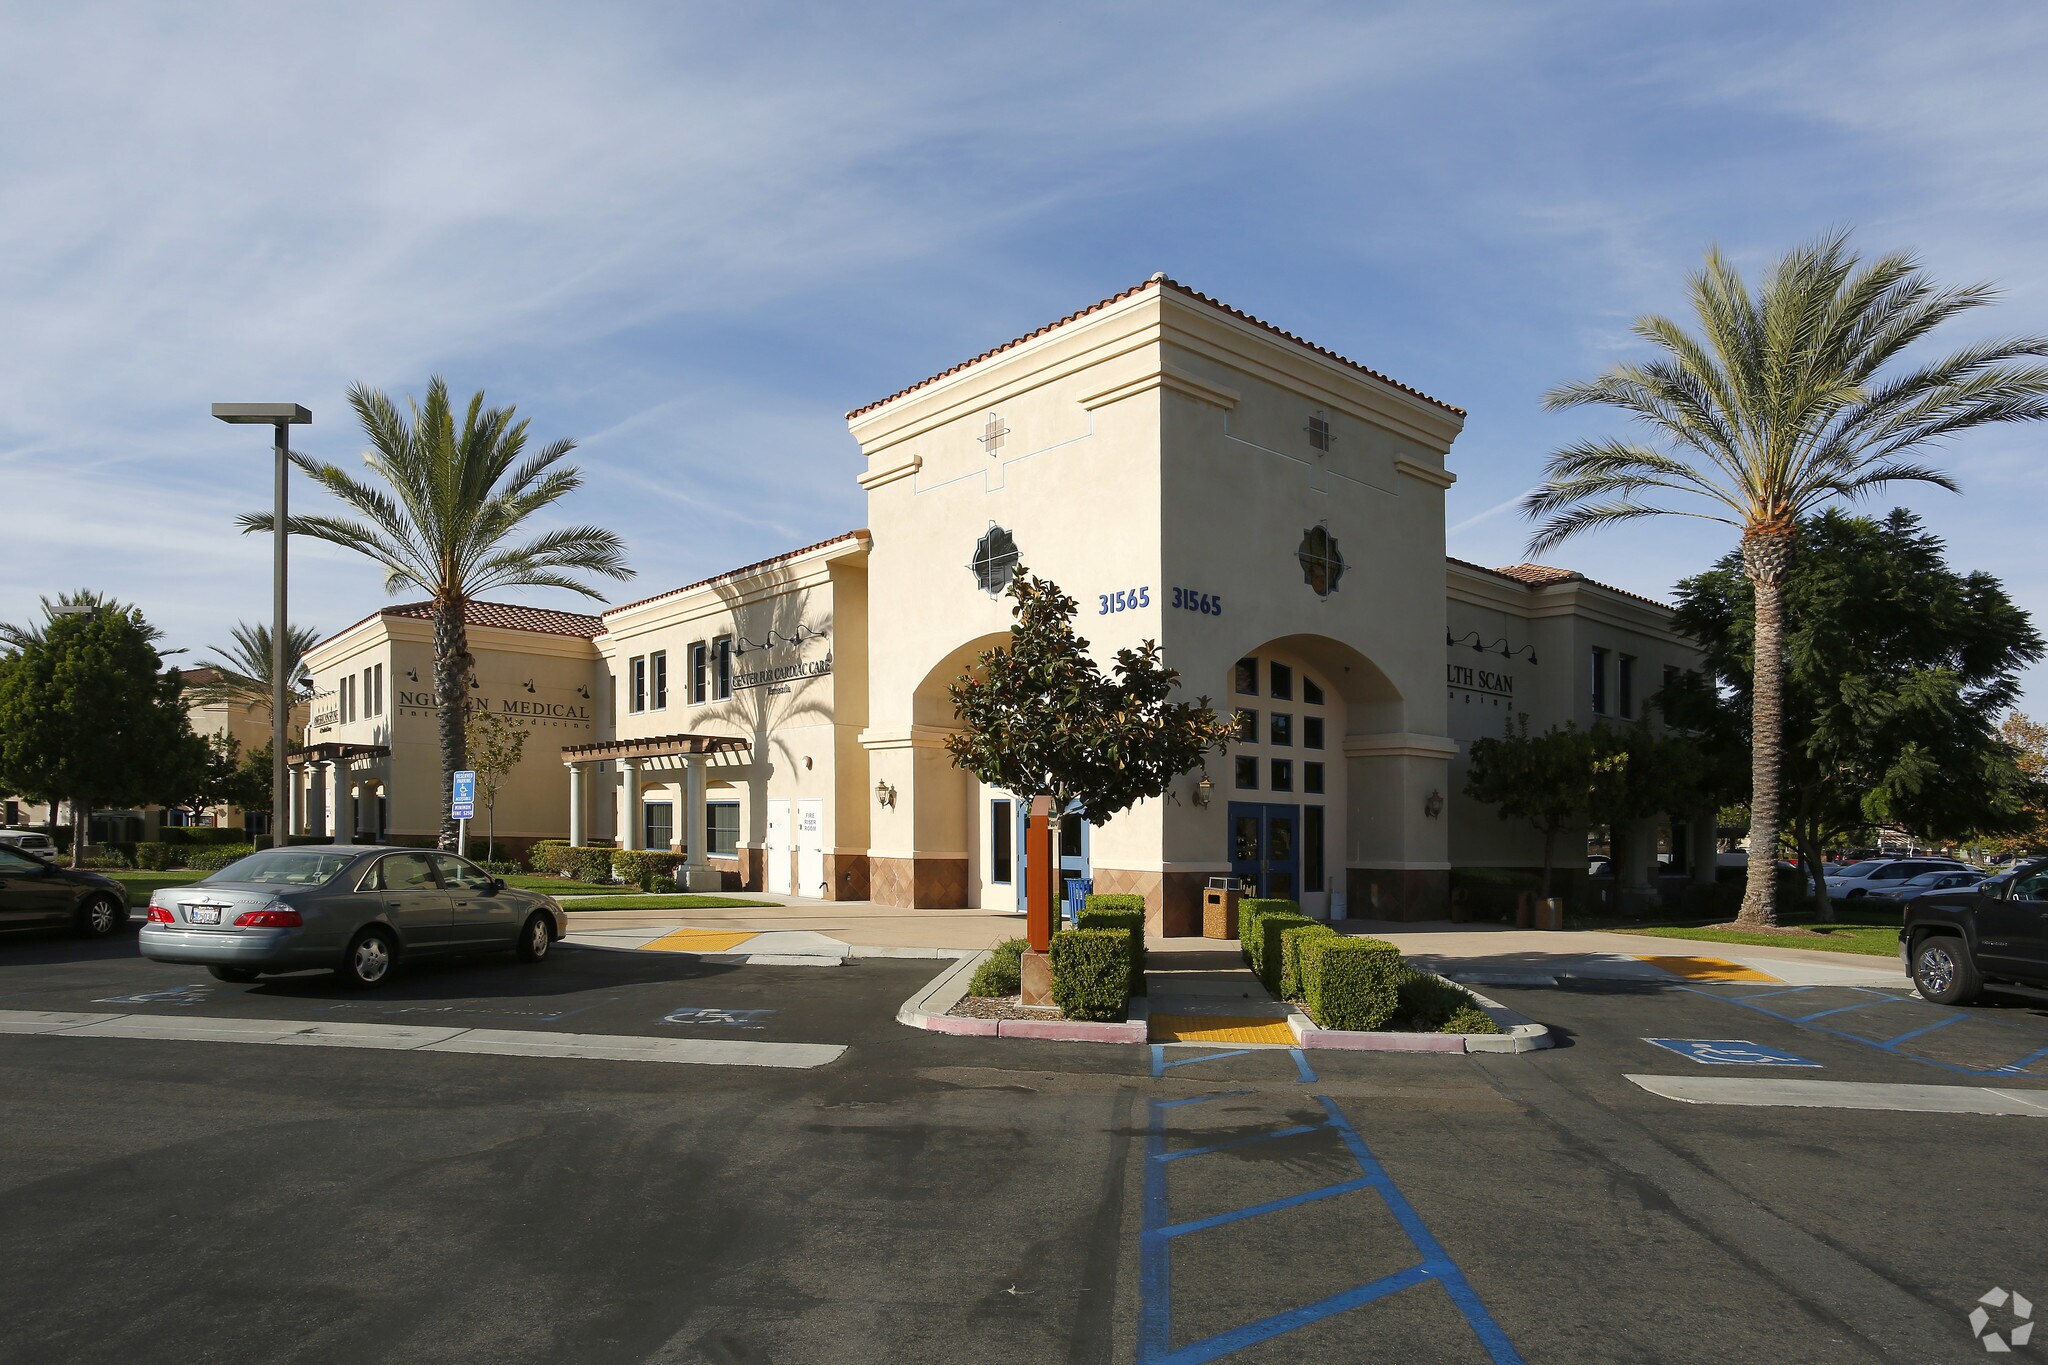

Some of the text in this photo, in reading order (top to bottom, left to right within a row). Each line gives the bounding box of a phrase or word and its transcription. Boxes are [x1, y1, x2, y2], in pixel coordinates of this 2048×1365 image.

[1099, 586, 1150, 616] 31565
[1172, 587, 1222, 616] 31565
[732, 659, 831, 687] CENTER FOR CARDIAC CARE
[1447, 664, 1513, 693] LTH SCAN
[502, 699, 590, 719] MEDICAL
[1449, 692, 1513, 711] aging
